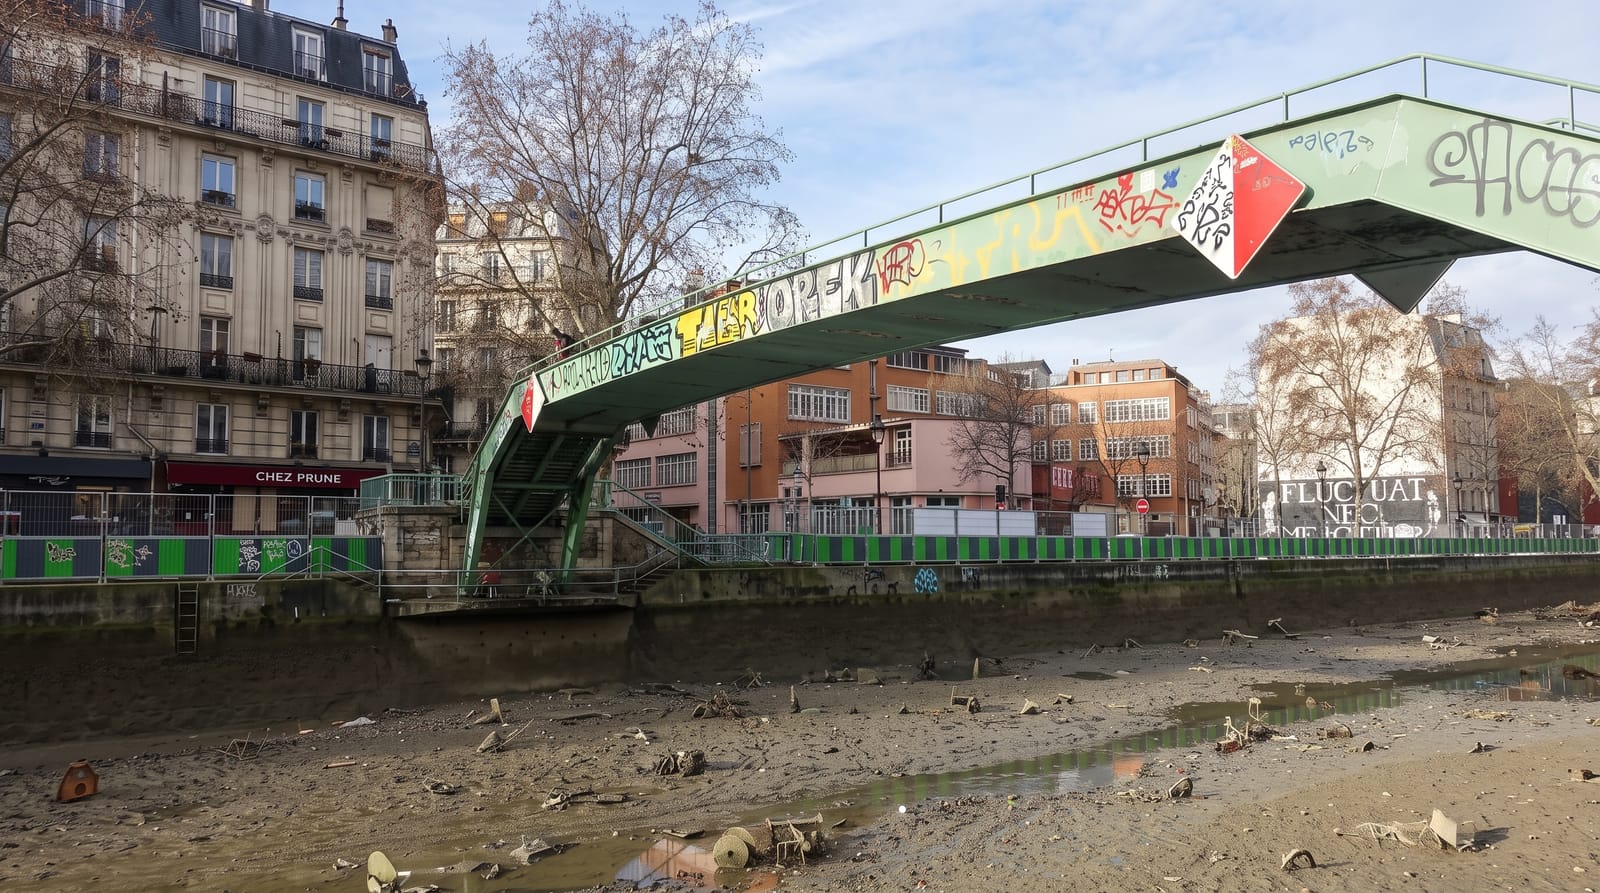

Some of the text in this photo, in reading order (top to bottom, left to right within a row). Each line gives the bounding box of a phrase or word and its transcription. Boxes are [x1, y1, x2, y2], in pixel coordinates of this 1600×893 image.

[256, 471, 341, 484] CHEZ PRUNE
[1280, 478, 1425, 503] FLUCUAT
[1321, 503, 1379, 525] NEC
